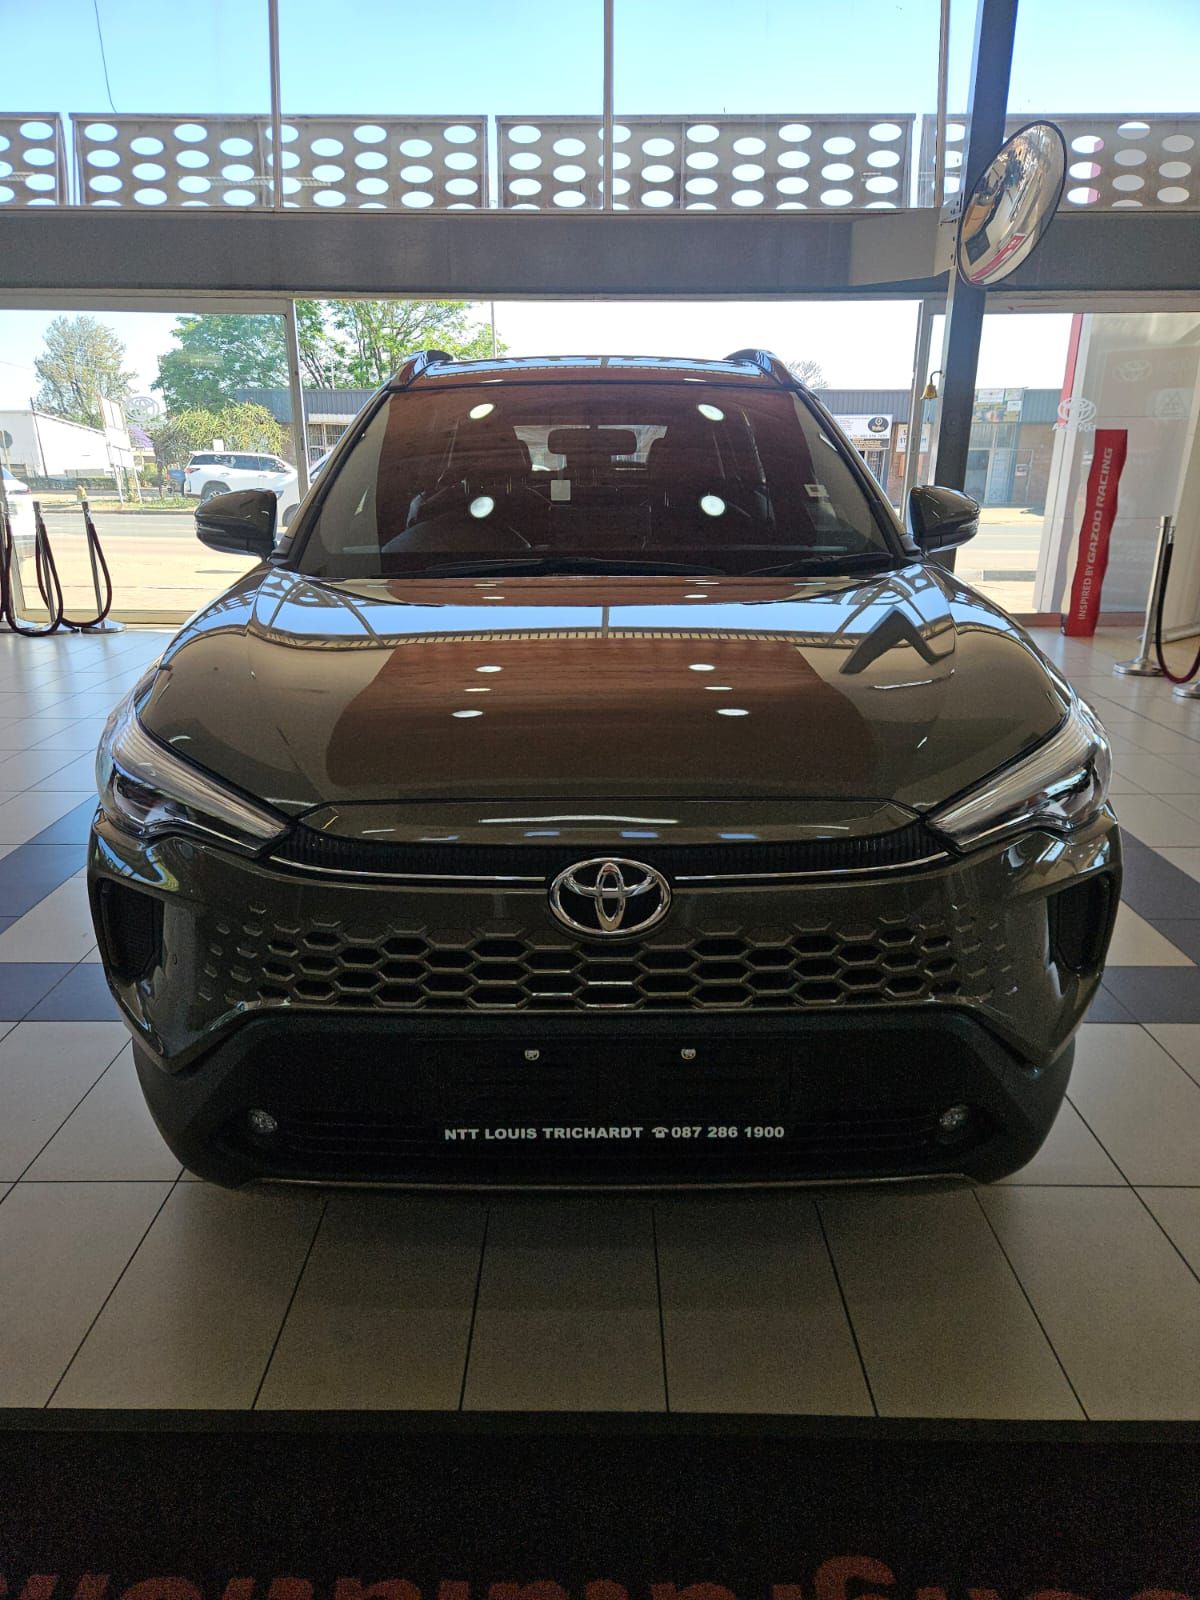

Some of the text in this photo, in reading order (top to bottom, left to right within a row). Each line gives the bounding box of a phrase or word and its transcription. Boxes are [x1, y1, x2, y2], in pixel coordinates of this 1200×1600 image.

[1078, 447, 1113, 620] INSPIRED BY GAZOO RACING
[444, 1126, 785, 1140] NTT LOUIS TRICHARDT 087 286 1900
